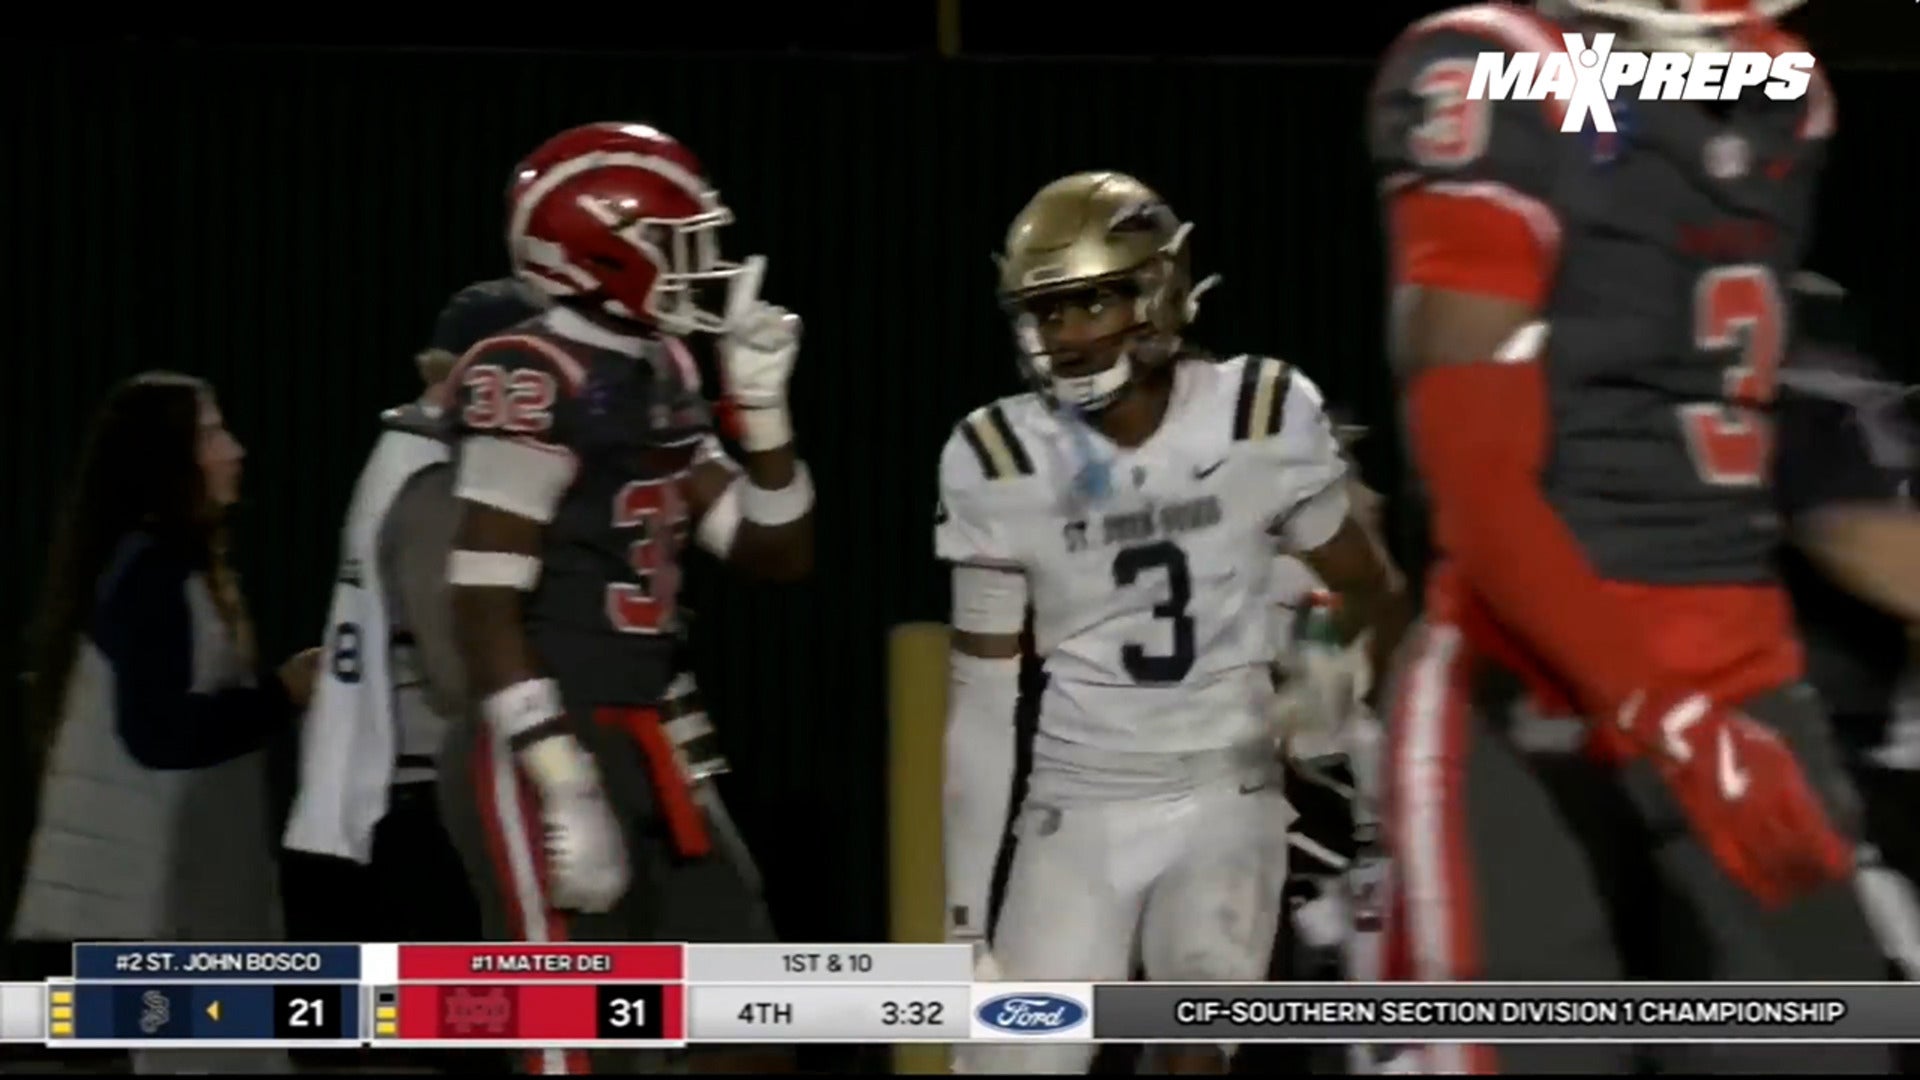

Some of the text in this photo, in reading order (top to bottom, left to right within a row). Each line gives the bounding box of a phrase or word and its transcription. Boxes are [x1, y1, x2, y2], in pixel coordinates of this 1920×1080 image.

[1407, 59, 1490, 169] 3
[461, 364, 558, 433] 32
[1676, 264, 1786, 486] 3
[1112, 541, 1195, 683] 3
